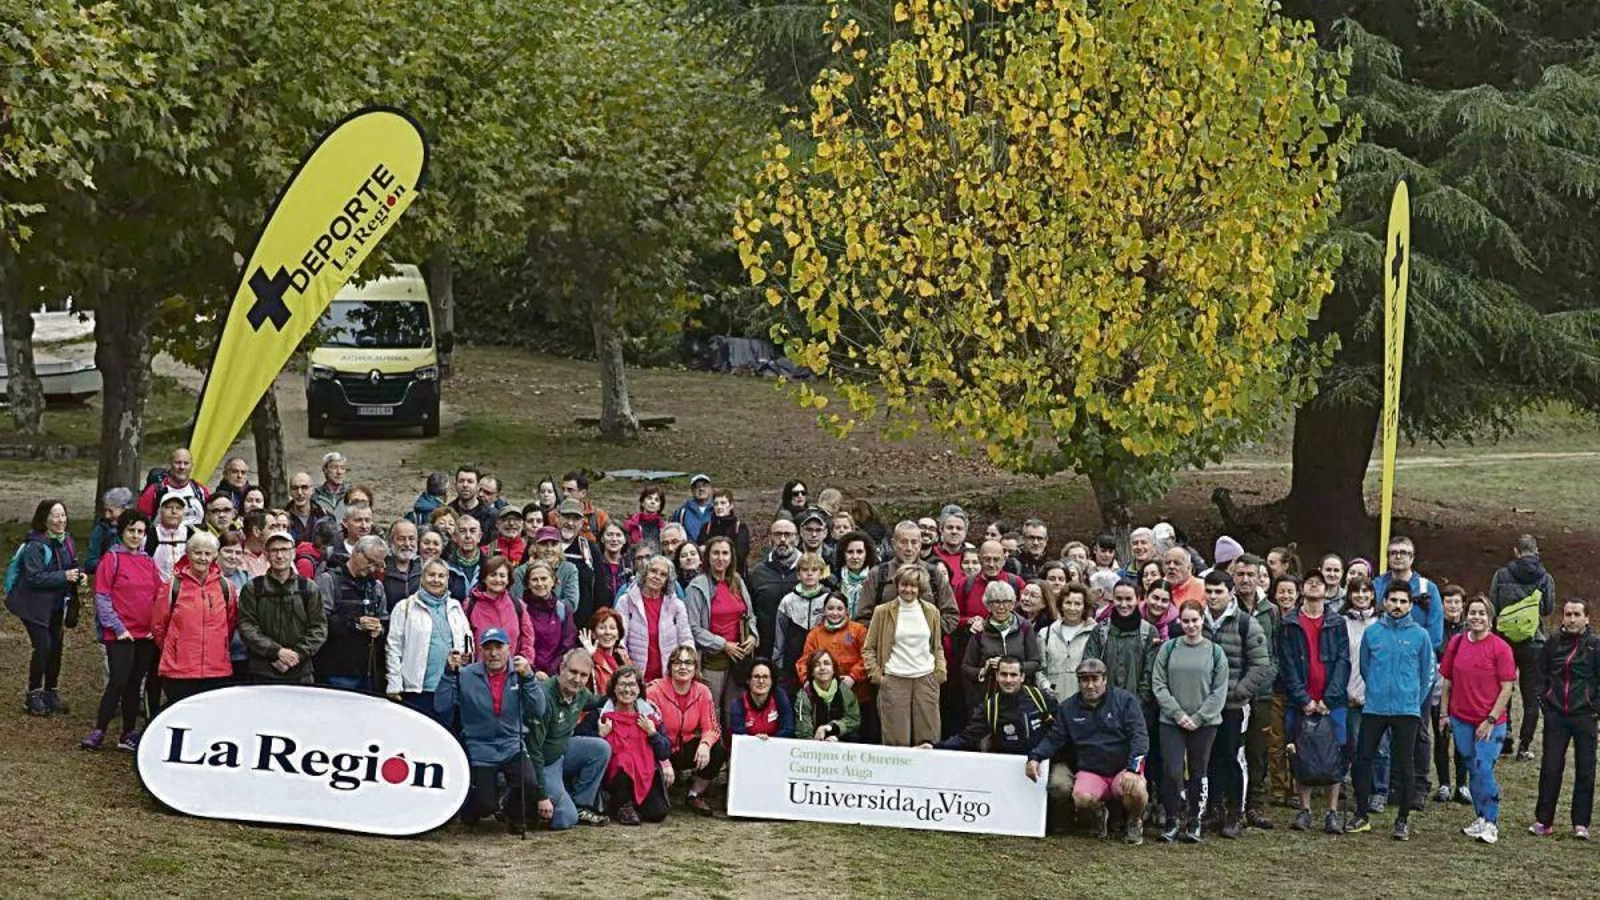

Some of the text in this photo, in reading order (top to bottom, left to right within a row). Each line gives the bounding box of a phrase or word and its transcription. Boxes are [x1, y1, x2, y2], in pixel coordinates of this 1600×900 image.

[290, 163, 395, 295] DEPORTE
[331, 246, 358, 271] La
[162, 726, 446, 791] La Región
[790, 747, 913, 766] Campus de Ourense
[789, 762, 873, 780] Campus Auga
[938, 792, 991, 823] Vigo
